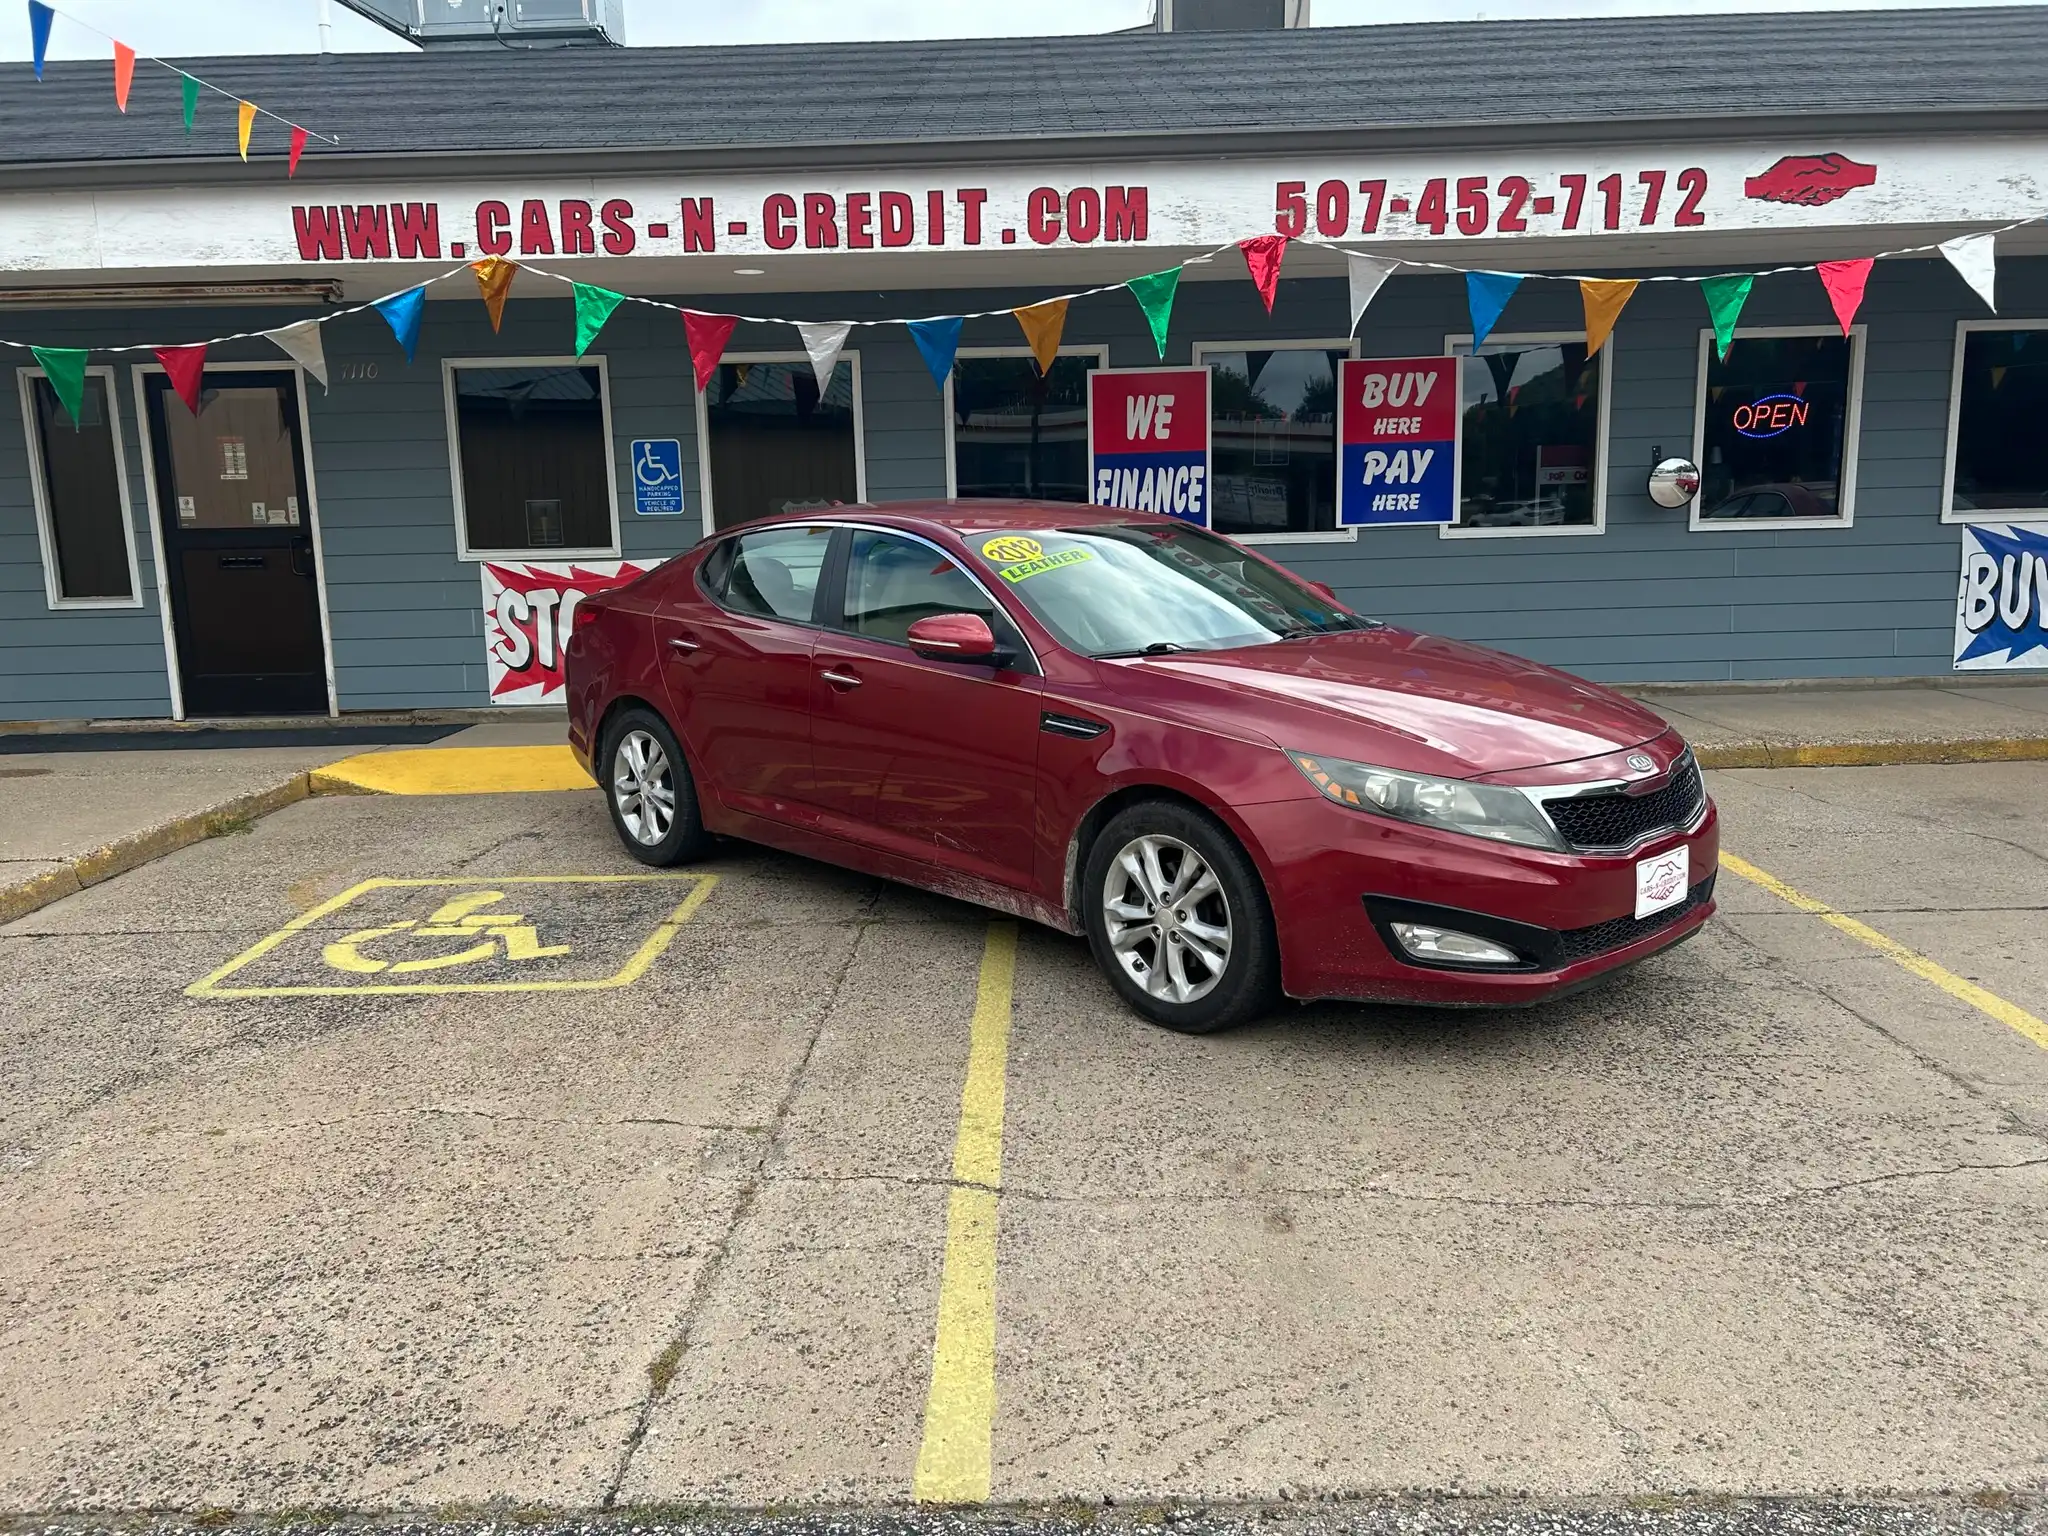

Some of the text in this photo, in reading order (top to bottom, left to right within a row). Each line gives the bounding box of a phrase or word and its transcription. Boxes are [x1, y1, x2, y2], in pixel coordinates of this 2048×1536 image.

[1275, 167, 1707, 238] 507-452-7172
[292, 186, 1148, 260] WWW.CARS-N-CREDIT.COM
[340, 362, 379, 380] 7110
[1361, 371, 1438, 409] BUY
[1126, 394, 1175, 441] WE
[1373, 416, 1422, 436] HERE
[1733, 402, 1809, 430] OPEN
[1362, 448, 1435, 486] PAY
[1097, 465, 1205, 514] FINANCE
[1371, 493, 1421, 512] HERE
[988, 539, 1039, 561] 2012
[1007, 550, 1084, 579] LEATHER
